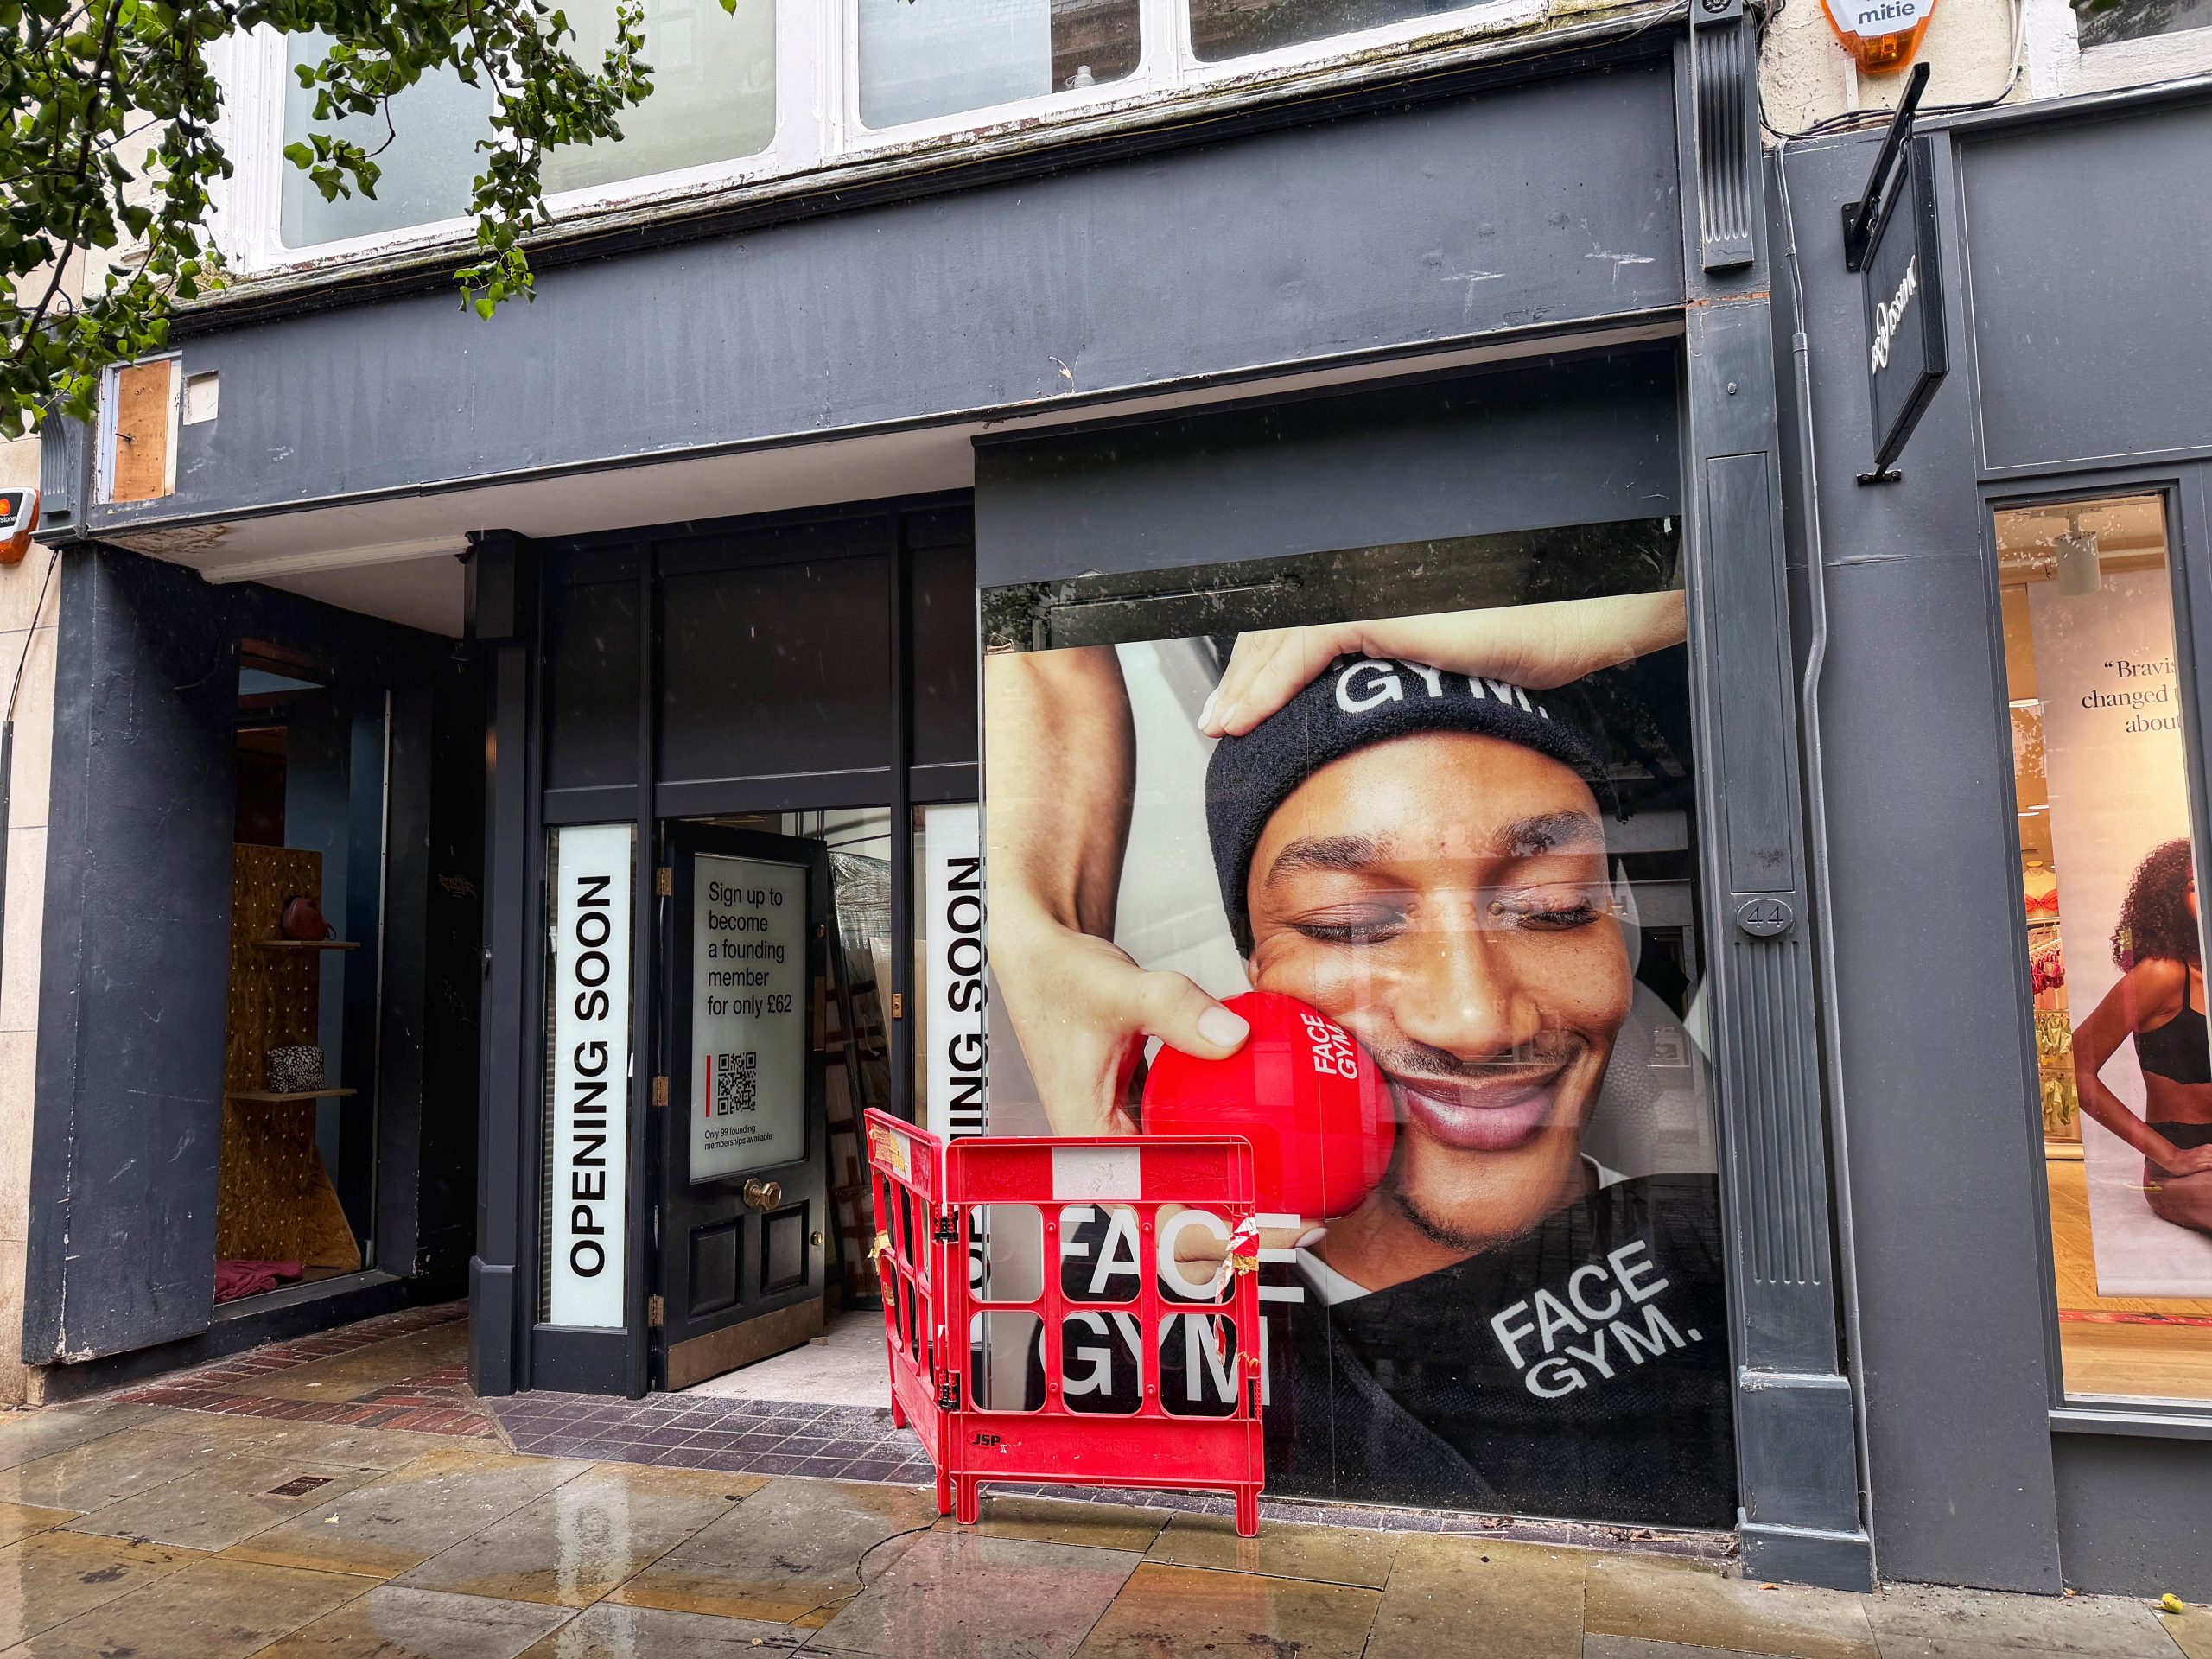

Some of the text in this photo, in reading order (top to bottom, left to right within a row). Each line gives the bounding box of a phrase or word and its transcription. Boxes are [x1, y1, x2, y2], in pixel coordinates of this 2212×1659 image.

[1859, 2, 1897, 25] mitie
[2082, 684, 2169, 709] changed
[709, 881, 783, 909] Sign up to
[709, 910, 768, 931] become
[1747, 906, 1783, 928] 44
[947, 857, 988, 1012] SOON
[708, 939, 785, 964] a founding
[708, 968, 769, 987] member
[707, 994, 792, 1019] for only £62
[1300, 1013, 1337, 1074] FACE
[570, 875, 611, 1278] OPENING SOON
[704, 1132, 772, 1150] memberships available
[705, 1125, 756, 1140] Only 99 founding
[1491, 1240, 1669, 1369] FACE
[1525, 1304, 1703, 1398] GYM.
[972, 1434, 1001, 1446] JSP
